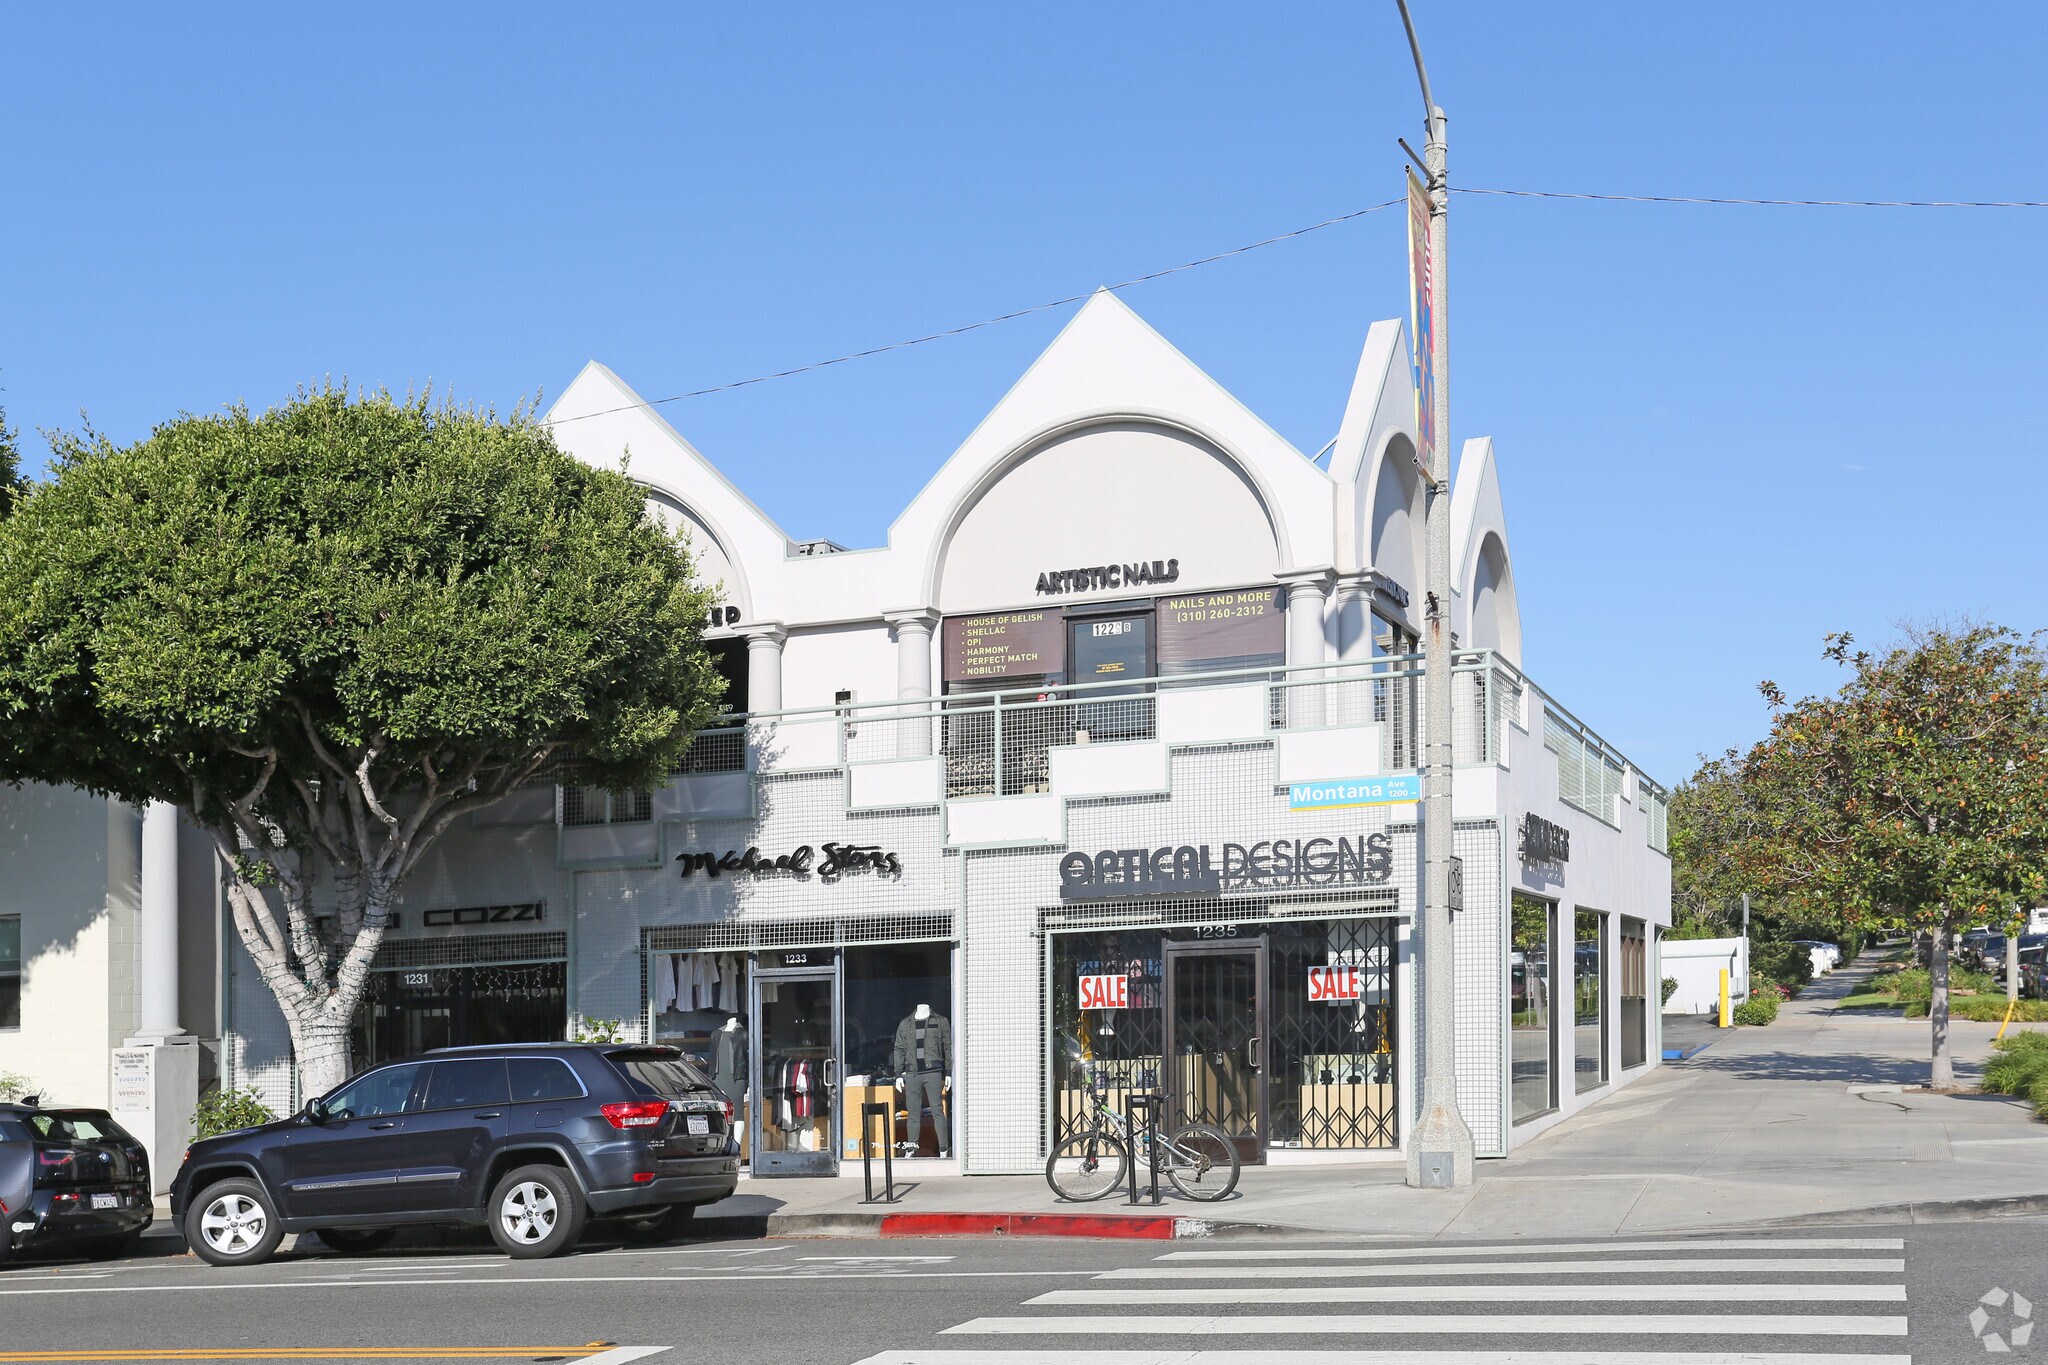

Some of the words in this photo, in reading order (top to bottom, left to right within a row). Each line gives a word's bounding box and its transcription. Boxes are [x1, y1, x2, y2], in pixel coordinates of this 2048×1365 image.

[1036, 564, 1121, 595] ARTISTIC
[1123, 559, 1179, 587] NAILS
[1170, 597, 1205, 610] NAILS
[1208, 595, 1234, 607] AND
[1237, 591, 1271, 604] MORE
[967, 617, 996, 627] HOUSE
[998, 616, 1009, 624] OF
[1011, 613, 1043, 623] GELISH
[1177, 609, 1206, 623] (310)
[1209, 606, 1264, 620] 260-2312
[967, 626, 1006, 637] SHELLAC
[967, 638, 981, 646] OPI
[967, 645, 1010, 656] HARMONY
[967, 655, 1005, 666] PERFECT
[1007, 653, 1038, 663] MATCH
[967, 665, 1007, 675] NOBILITY
[1293, 784, 1382, 802] Montana
[1387, 780, 1405, 789] Ave
[1389, 789, 1408, 798] 1200
[675, 846, 814, 878] Michael
[817, 842, 899, 877] Stars
[423, 903, 543, 927] COZZI
[1193, 924, 1238, 939] 1235
[785, 953, 807, 964] 1233
[404, 972, 429, 985] 1231
[1310, 966, 1359, 999] SALE
[1081, 976, 1126, 1009] SALE
